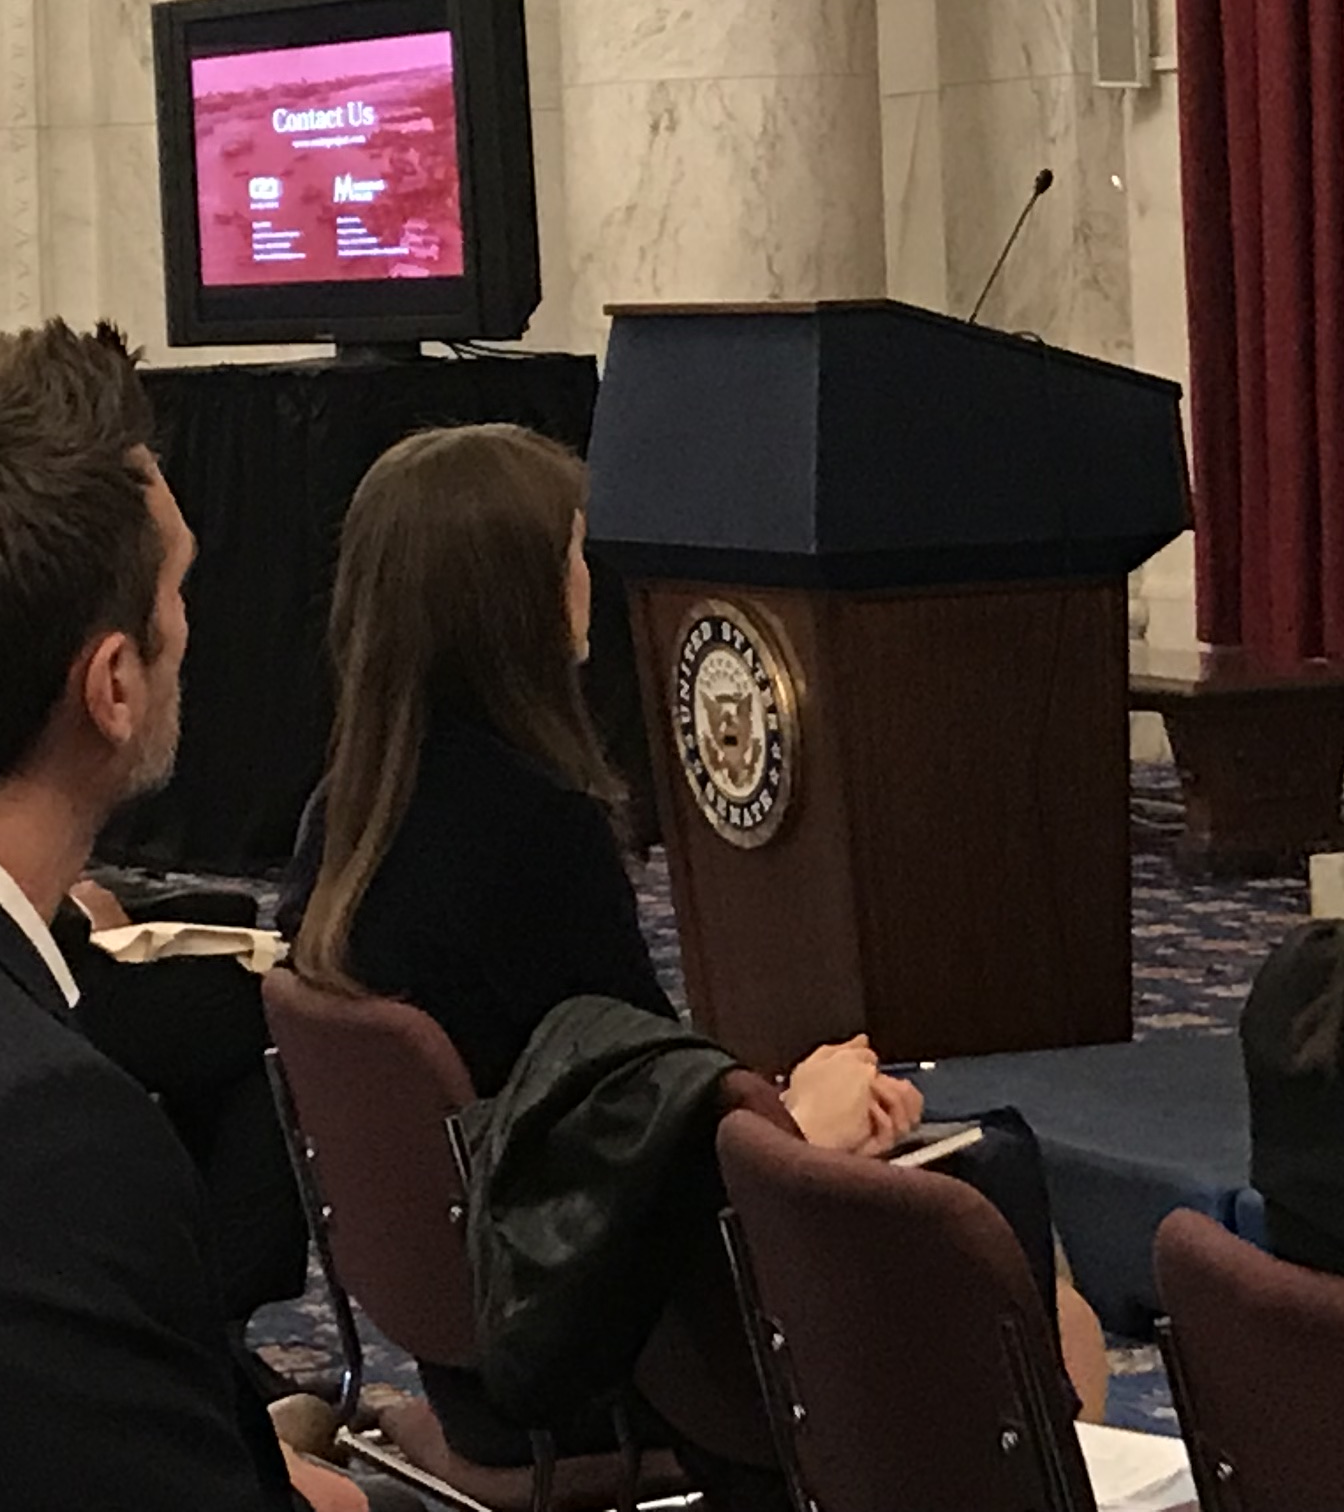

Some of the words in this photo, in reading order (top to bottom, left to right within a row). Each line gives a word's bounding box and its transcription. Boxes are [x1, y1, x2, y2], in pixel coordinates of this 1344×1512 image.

[272, 107, 344, 133] Contact
[347, 101, 375, 127] Us
[679, 621, 713, 724] UNITED
